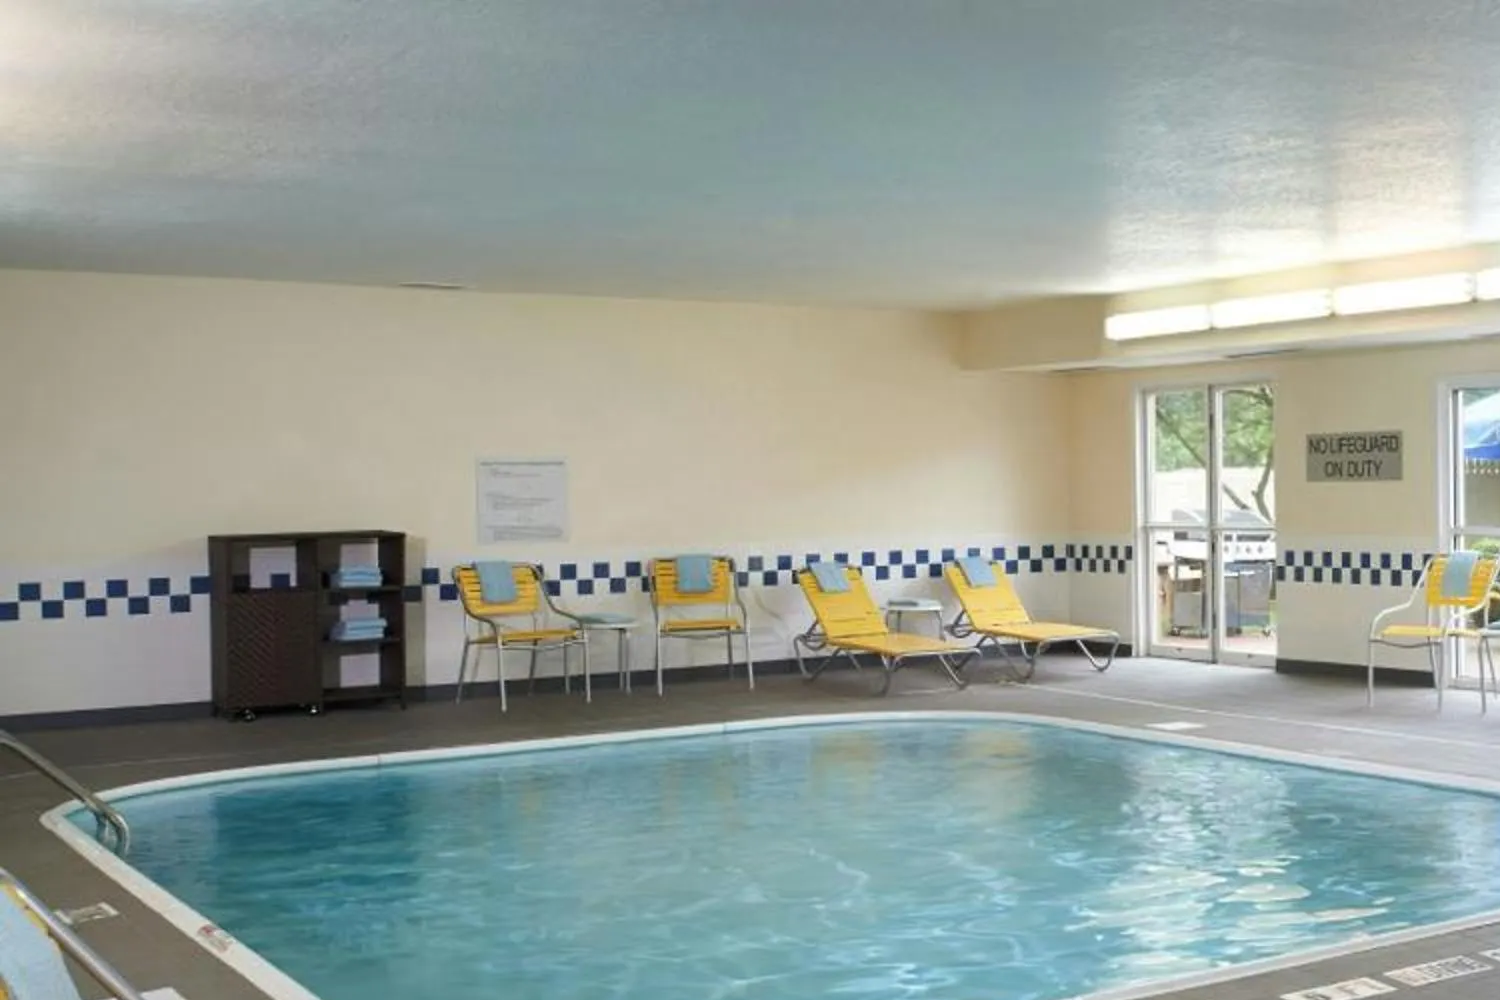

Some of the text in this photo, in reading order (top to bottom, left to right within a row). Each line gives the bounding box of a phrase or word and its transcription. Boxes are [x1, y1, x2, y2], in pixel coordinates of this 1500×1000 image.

[1309, 435, 1399, 455] NO LIFEGUARD
[1325, 460, 1383, 477] ON DUTY
